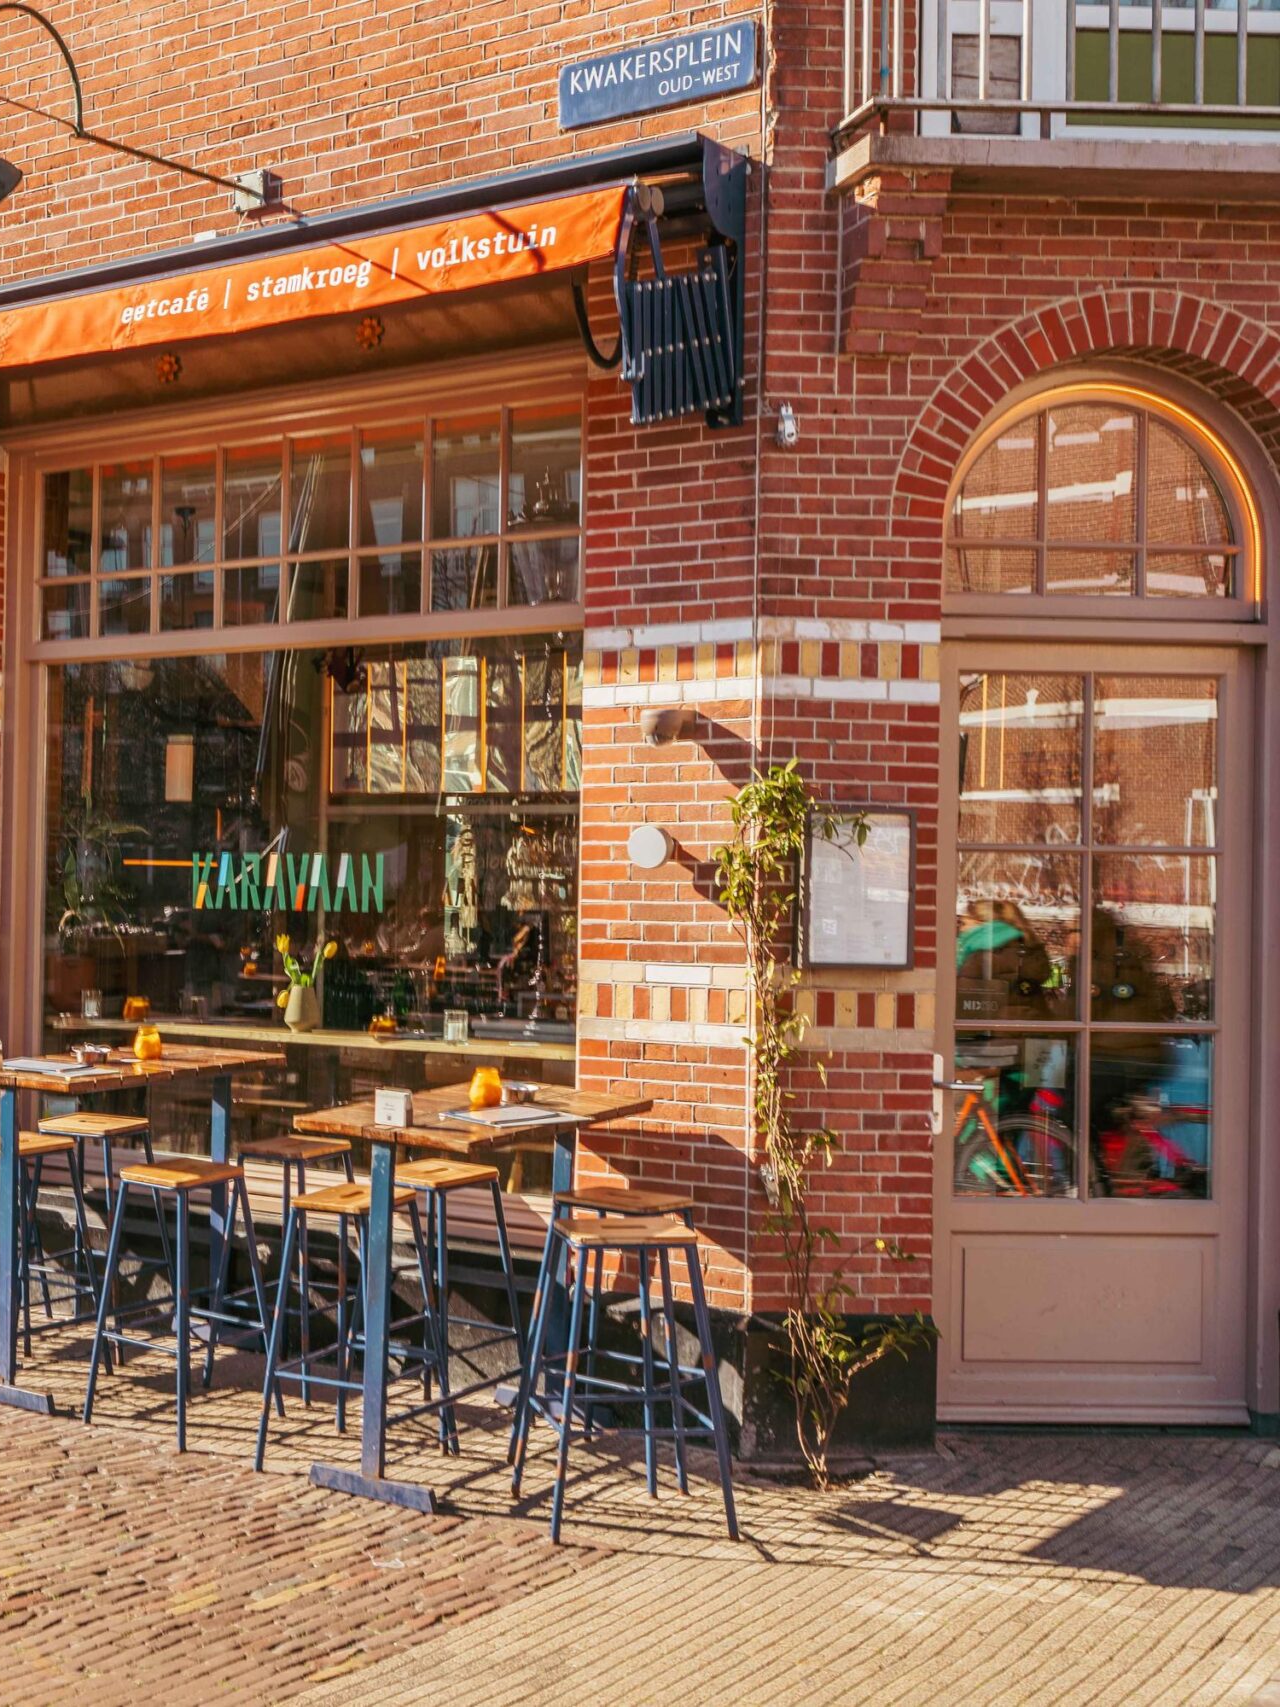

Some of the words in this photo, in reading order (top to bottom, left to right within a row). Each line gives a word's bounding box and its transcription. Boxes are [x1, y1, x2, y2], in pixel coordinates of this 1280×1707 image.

[570, 29, 742, 95] KWAKERSPLEIN
[658, 63, 740, 96] OUD-WEST
[120, 287, 210, 325] eetcafé
[246, 260, 372, 302] stamkroeg
[417, 224, 557, 270] volkstuin
[192, 852, 384, 913] KARAVAAN
